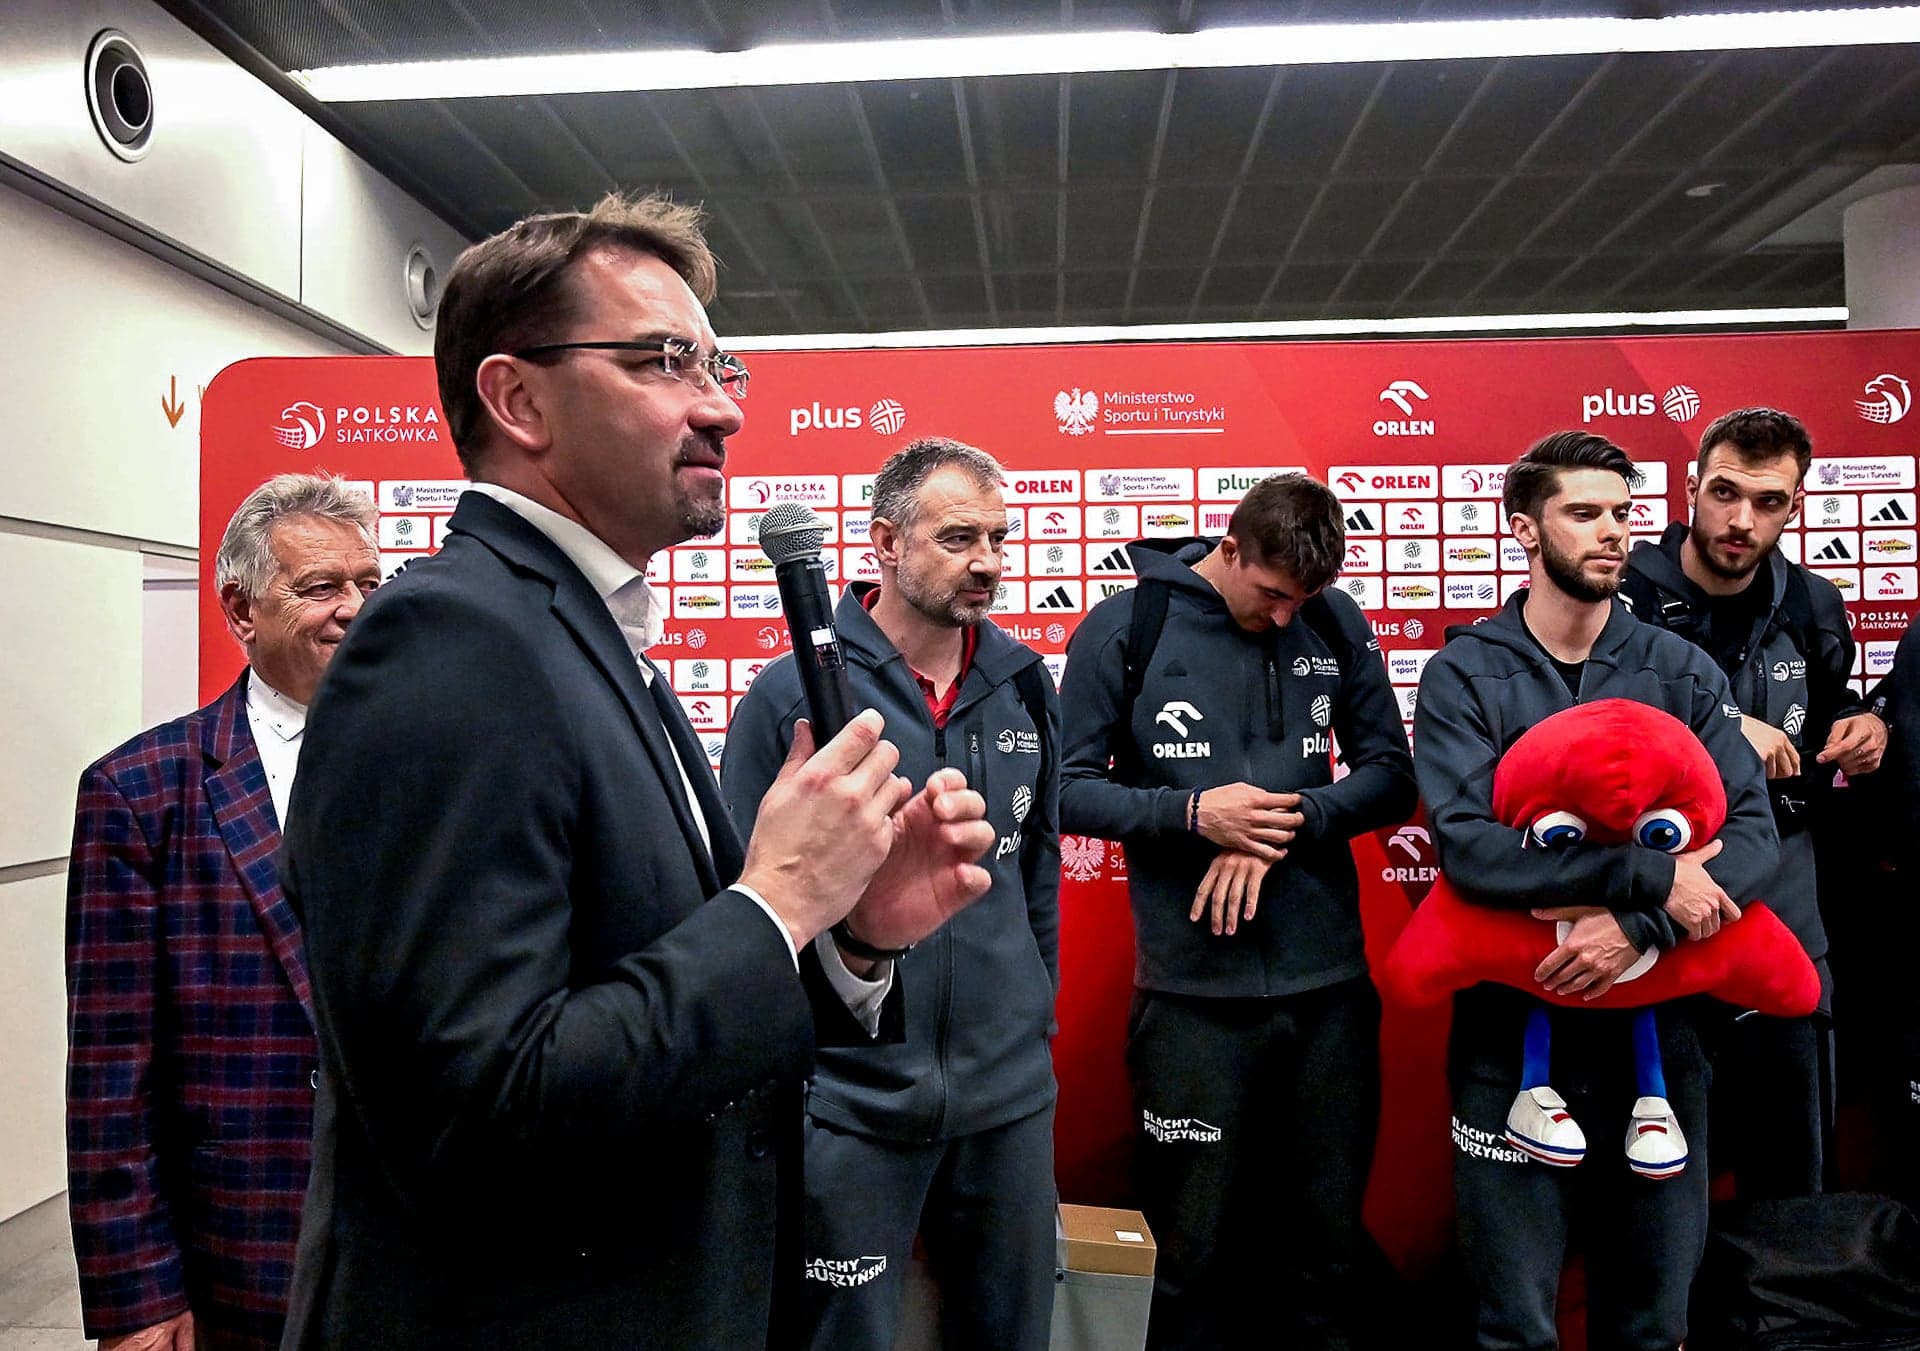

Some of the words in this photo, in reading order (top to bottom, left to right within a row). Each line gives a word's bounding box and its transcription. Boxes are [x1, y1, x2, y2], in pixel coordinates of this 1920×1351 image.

[1104, 391, 1195, 405] Ministerstwo
[1582, 388, 1656, 422] plus
[336, 406, 439, 424] POLSKA
[790, 402, 863, 436] plus
[1104, 408, 1151, 424] Sportu
[1154, 407, 1158, 421] i
[1162, 406, 1225, 422] Turystyki
[1373, 420, 1435, 436] ORLEN
[336, 426, 439, 443] SIATKÓWKA
[1371, 475, 1430, 489] ORLEN
[776, 483, 826, 492] POLSKA
[1015, 480, 1073, 494] ORLEN
[1823, 517, 1841, 525] plus
[1102, 528, 1120, 536] plus
[1460, 524, 1479, 532] plus
[395, 538, 414, 546] plus
[1503, 547, 1525, 555] pols
[1508, 554, 1525, 562] spor
[1046, 566, 1064, 574] plus
[1403, 562, 1422, 570] plus
[690, 572, 709, 580] plus
[1448, 584, 1473, 592] polsat
[733, 594, 759, 602] polsat
[1451, 592, 1474, 600] sport
[738, 601, 759, 609] sport
[1860, 611, 1908, 621] POLSKA
[1371, 619, 1400, 636] lus
[1860, 621, 1908, 630] SIATKÓWKA
[1391, 658, 1417, 667] polsat
[1396, 666, 1417, 674] sport
[691, 681, 709, 690] plus
[1303, 732, 1330, 758] plu
[1152, 742, 1211, 758] ORLEN
[996, 831, 1021, 860] plu
[1381, 867, 1440, 882] ORLEN
[1143, 1109, 1191, 1129] BLACHY
[805, 1258, 860, 1273] LACHY
[805, 1259, 887, 1288] RUSZYŃSKI
